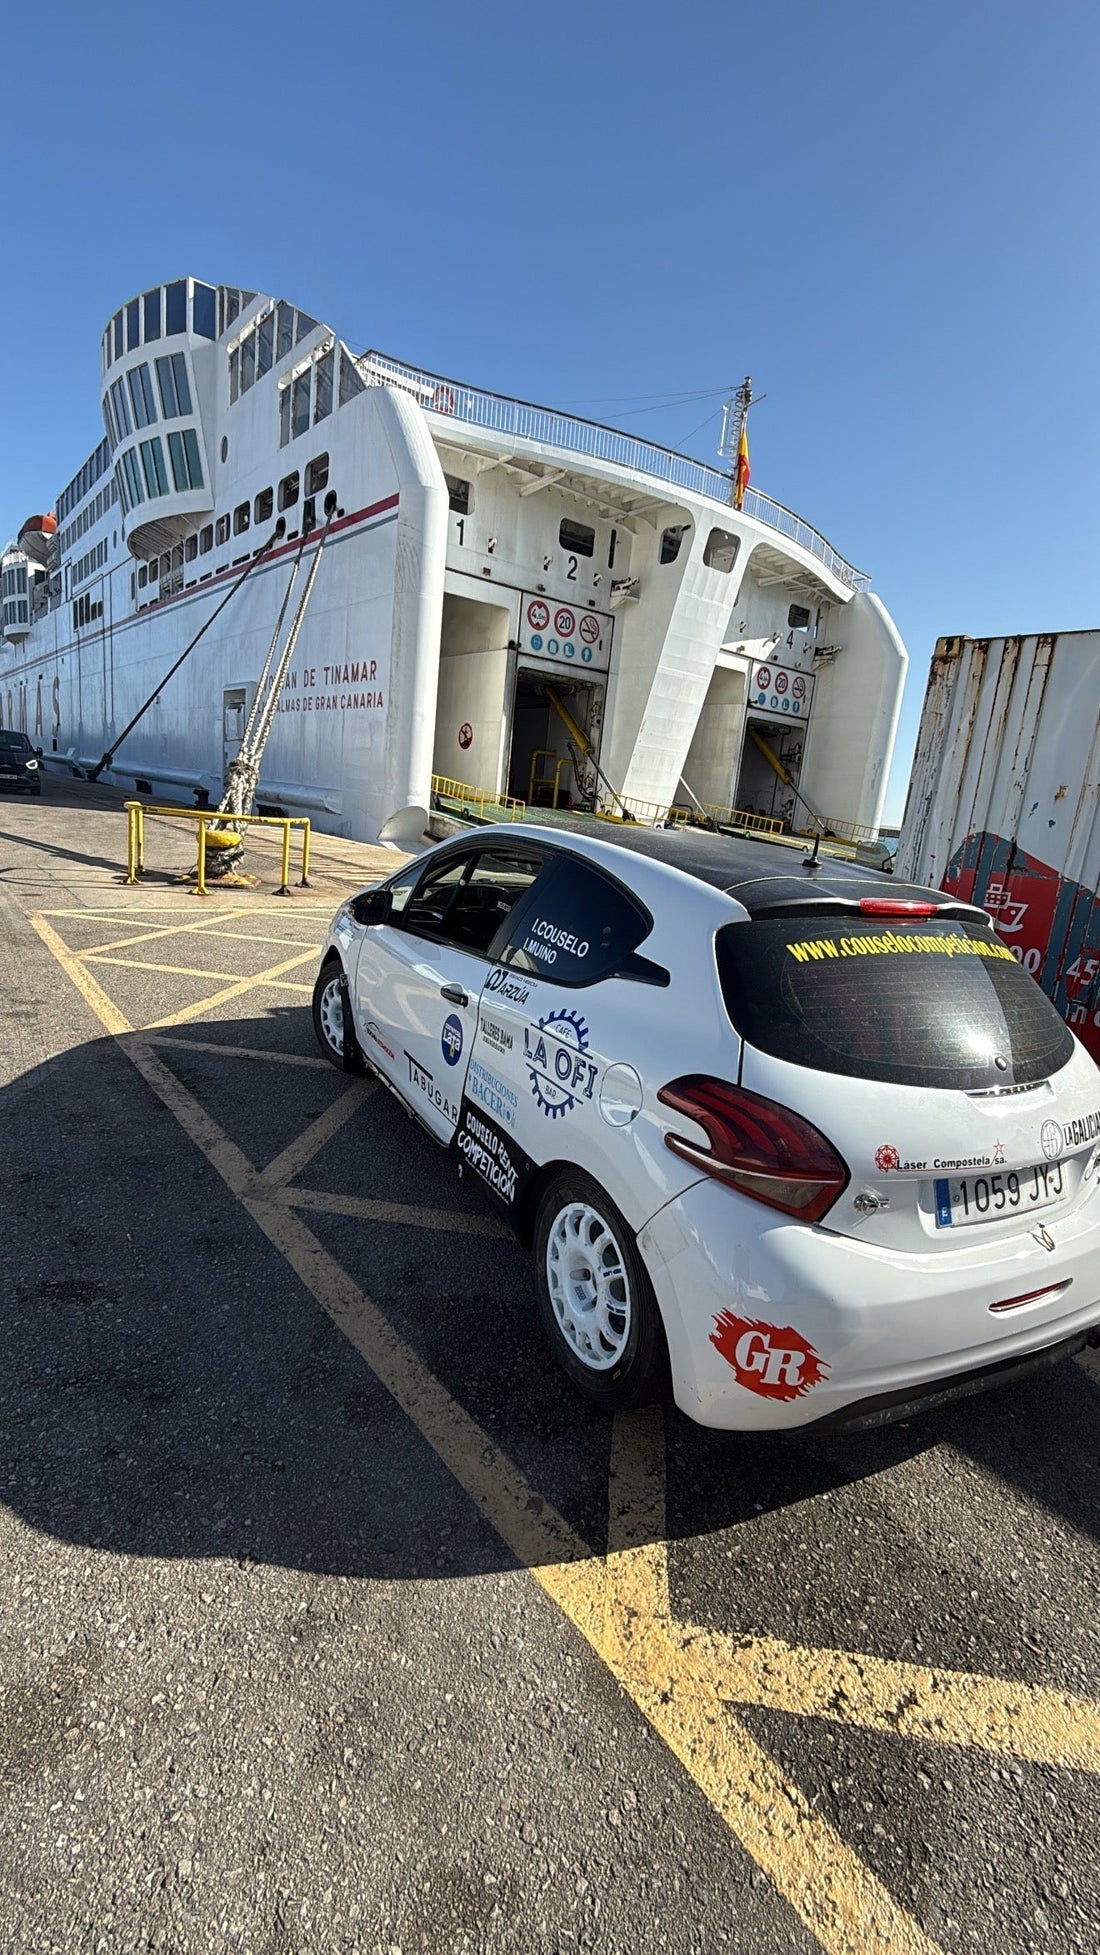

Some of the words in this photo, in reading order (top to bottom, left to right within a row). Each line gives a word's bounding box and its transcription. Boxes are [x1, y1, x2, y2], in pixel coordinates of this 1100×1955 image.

[456, 519, 464, 546] 1
[567, 556, 578, 581] 2
[558, 615, 571, 630] 20
[786, 630, 795, 649] 4
[303, 668, 316, 688] DE
[323, 660, 378, 686] TINAMAR
[303, 697, 313, 711] DE
[315, 695, 338, 711] GRAN
[340, 691, 384, 709] CANARIA
[522, 937, 557, 964] I.MUIÑO
[531, 918, 589, 958] I.COUSELO
[786, 930, 1020, 964] www.couselocompeticion.com
[497, 983, 530, 1005] ARZÚA
[523, 1028, 547, 1069] LA
[555, 1048, 598, 1099] OFI
[403, 1049, 459, 1123] TABUGAR
[470, 1058, 518, 1108] DISTRIBUCIONES
[544, 1085, 558, 1100] BAR
[466, 1112, 498, 1154] COUSELO
[498, 1142, 519, 1186] RENT
[1063, 1126, 1073, 1147] LA
[457, 1130, 515, 1203] COMPETICION
[896, 1158, 927, 1171] Láser
[933, 1156, 990, 1169] Compostela
[959, 1172, 1021, 1216] 1059
[1029, 1162, 1064, 1202] JYJ
[941, 1209, 949, 1218] E
[735, 1330, 806, 1387] GR
